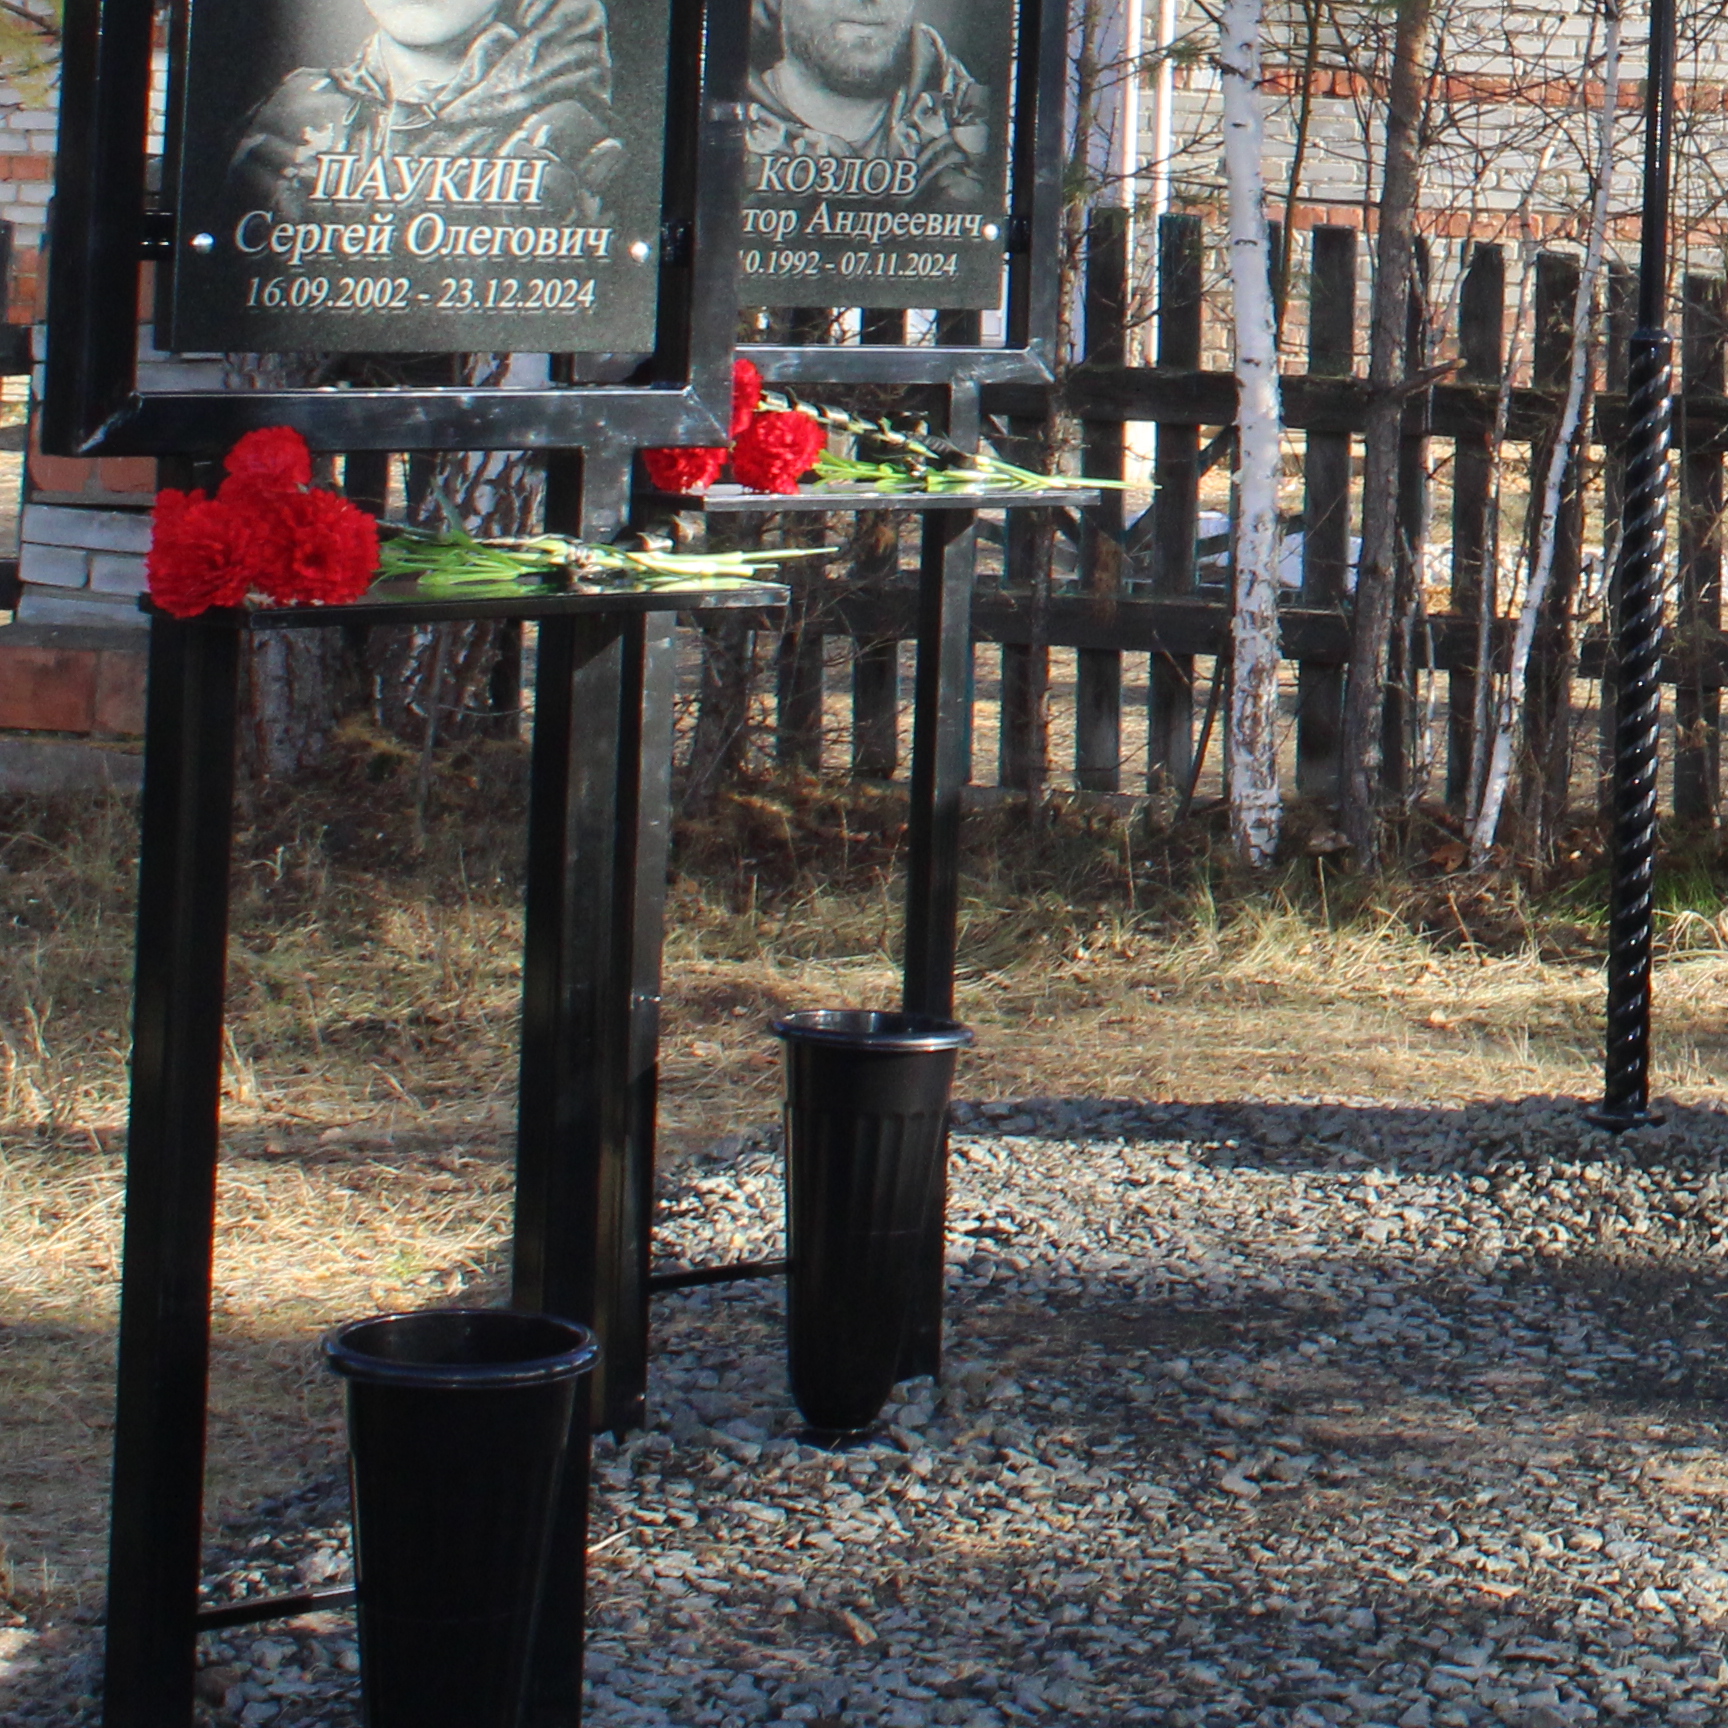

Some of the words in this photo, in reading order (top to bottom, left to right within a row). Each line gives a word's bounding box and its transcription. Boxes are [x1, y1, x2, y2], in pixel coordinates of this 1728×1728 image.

[310, 154, 550, 204] ПАУКИН
[757, 156, 918, 195] КОЗЛОВ
[235, 210, 397, 263] Сергей
[408, 213, 612, 259] Олегович
[742, 207, 797, 241] тор
[805, 201, 983, 242] Андреевич
[740, 250, 819, 275] .0.1992
[841, 251, 957, 276] 07.11.2024
[246, 276, 410, 309] 16.09.2002
[437, 278, 596, 310] 23.12.2024
